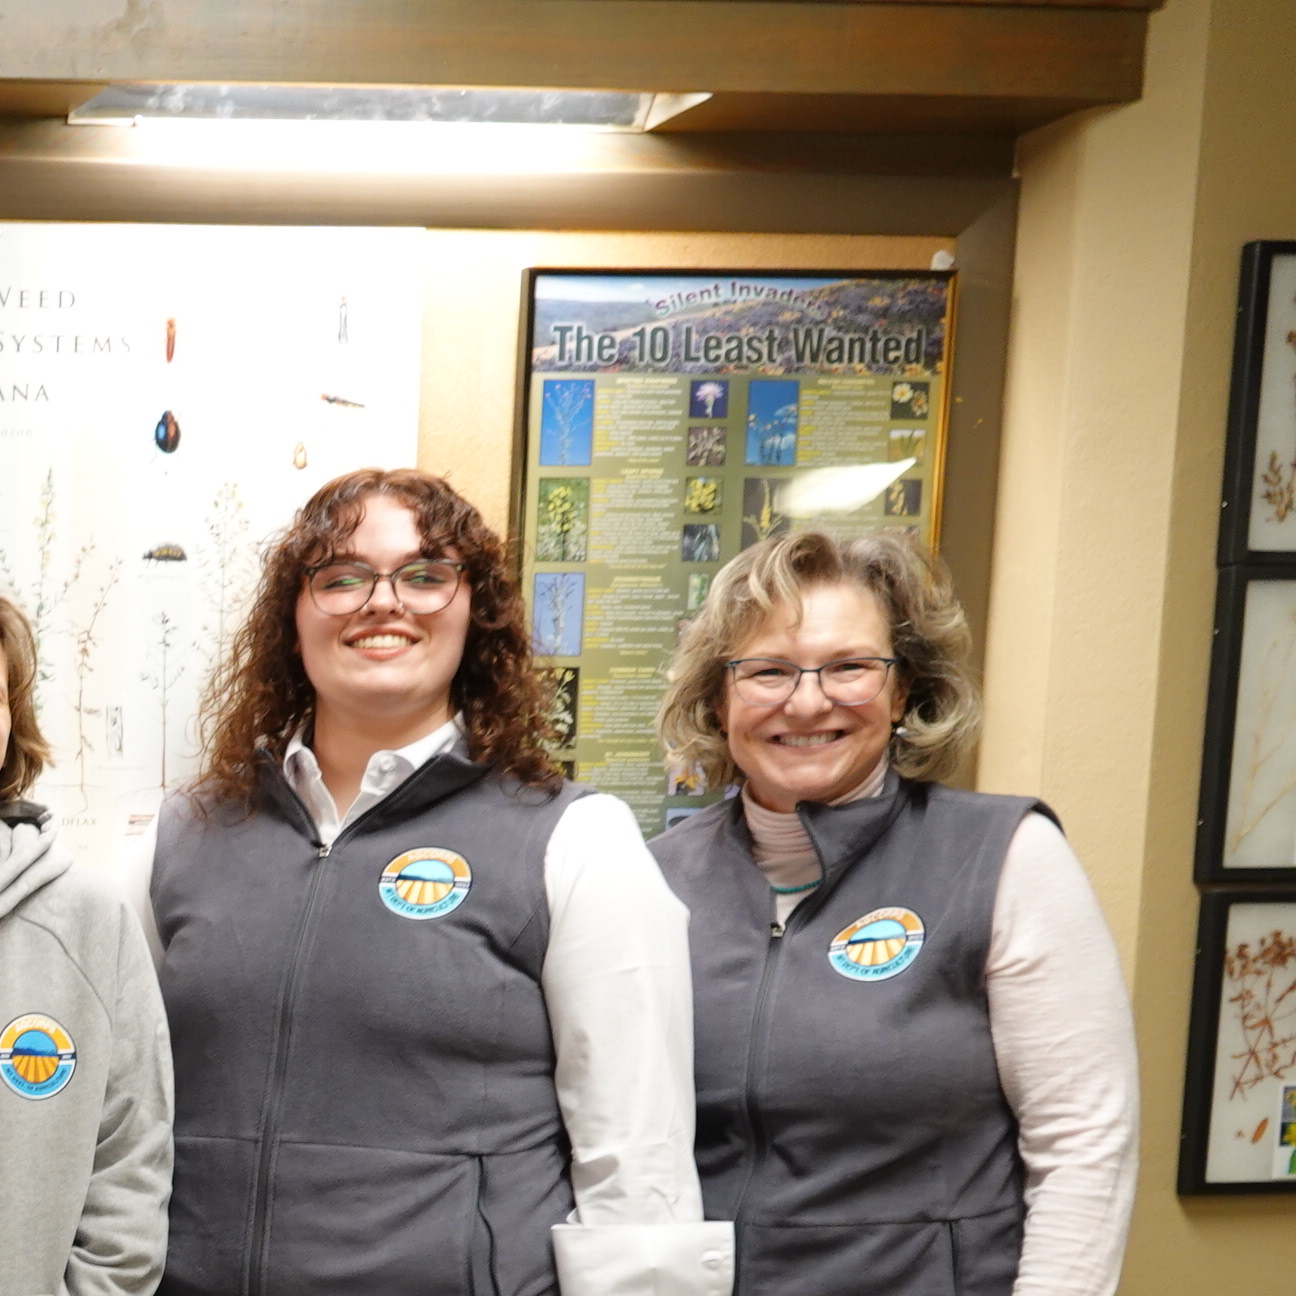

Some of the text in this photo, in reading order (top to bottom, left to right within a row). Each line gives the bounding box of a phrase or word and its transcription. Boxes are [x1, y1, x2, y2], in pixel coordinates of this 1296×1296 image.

[655, 282, 721, 316] Silent
[552, 324, 926, 365] The 10 Least Wanted
